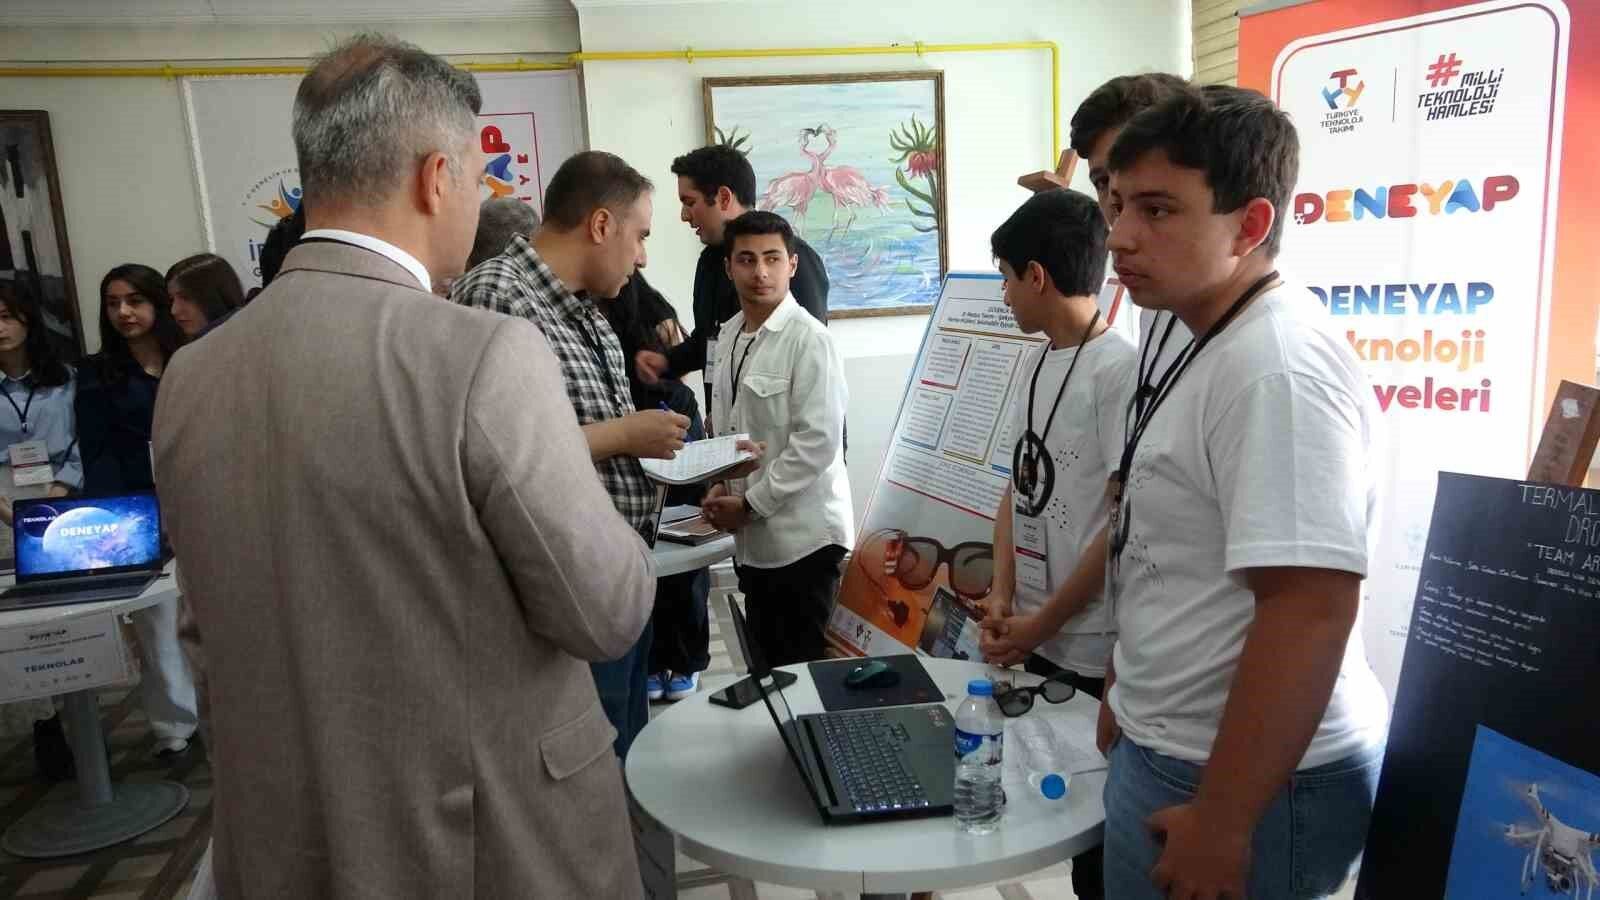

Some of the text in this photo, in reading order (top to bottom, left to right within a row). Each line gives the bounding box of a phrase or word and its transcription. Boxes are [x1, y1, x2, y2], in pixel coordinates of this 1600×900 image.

[481, 125, 514, 199] YAP
[517, 152, 533, 201] İYE
[1294, 174, 1520, 225] DENEYAP
[1346, 329, 1486, 372] knoloji
[1372, 376, 1492, 413] yeleri
[59, 523, 119, 538] DENEYAP
[1564, 514, 1600, 547] DRO
